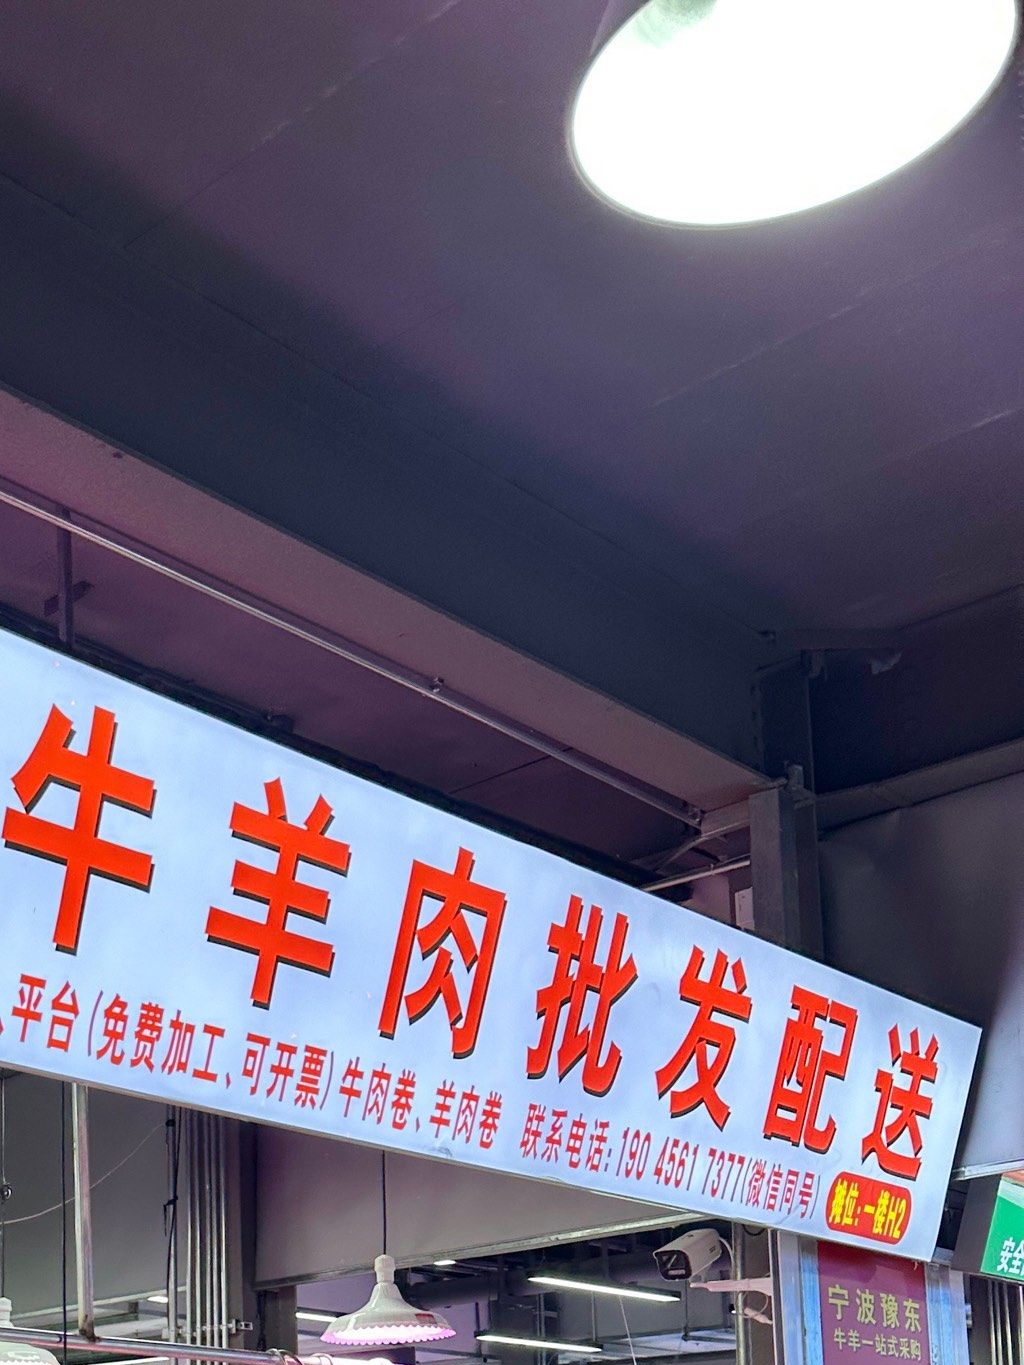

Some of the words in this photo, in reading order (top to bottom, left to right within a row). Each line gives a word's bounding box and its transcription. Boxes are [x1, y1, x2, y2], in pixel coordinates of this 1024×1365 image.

[653, 1136, 700, 1192] 4561
[828, 1283, 922, 1333] 宁波豫东
[833, 1326, 922, 1362] 牛羊一站式采购
